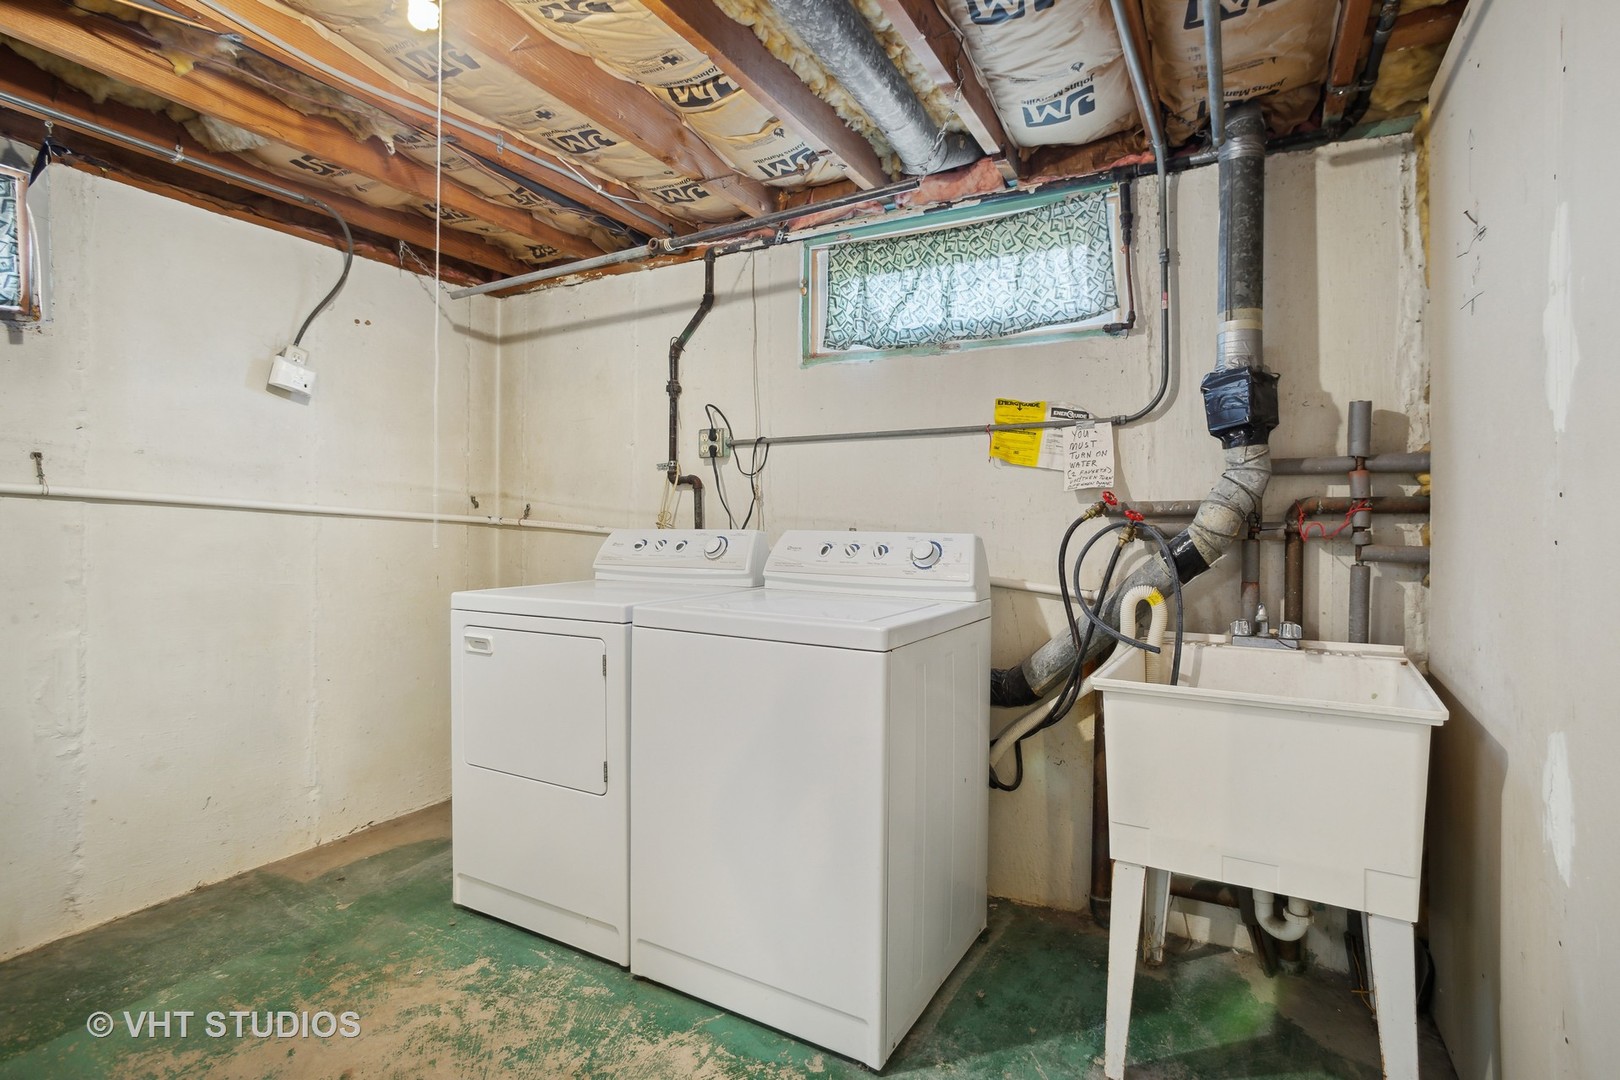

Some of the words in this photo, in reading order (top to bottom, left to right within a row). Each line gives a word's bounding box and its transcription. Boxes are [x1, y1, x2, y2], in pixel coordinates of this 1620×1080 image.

[693, 65, 718, 81] Johns
[1064, 73, 1095, 91] Johns
[1250, 77, 1287, 93] Johns
[1022, 85, 1095, 128] JM
[547, 130, 617, 154] JM
[783, 142, 806, 156] Johns
[752, 152, 784, 164] Manville
[652, 183, 710, 203] JM
[1071, 429, 1089, 442] YOU
[1069, 440, 1097, 451] MUST
[1069, 451, 1092, 460] TURN
[1096, 450, 1108, 458] ON
[1069, 460, 1098, 469] WATER
